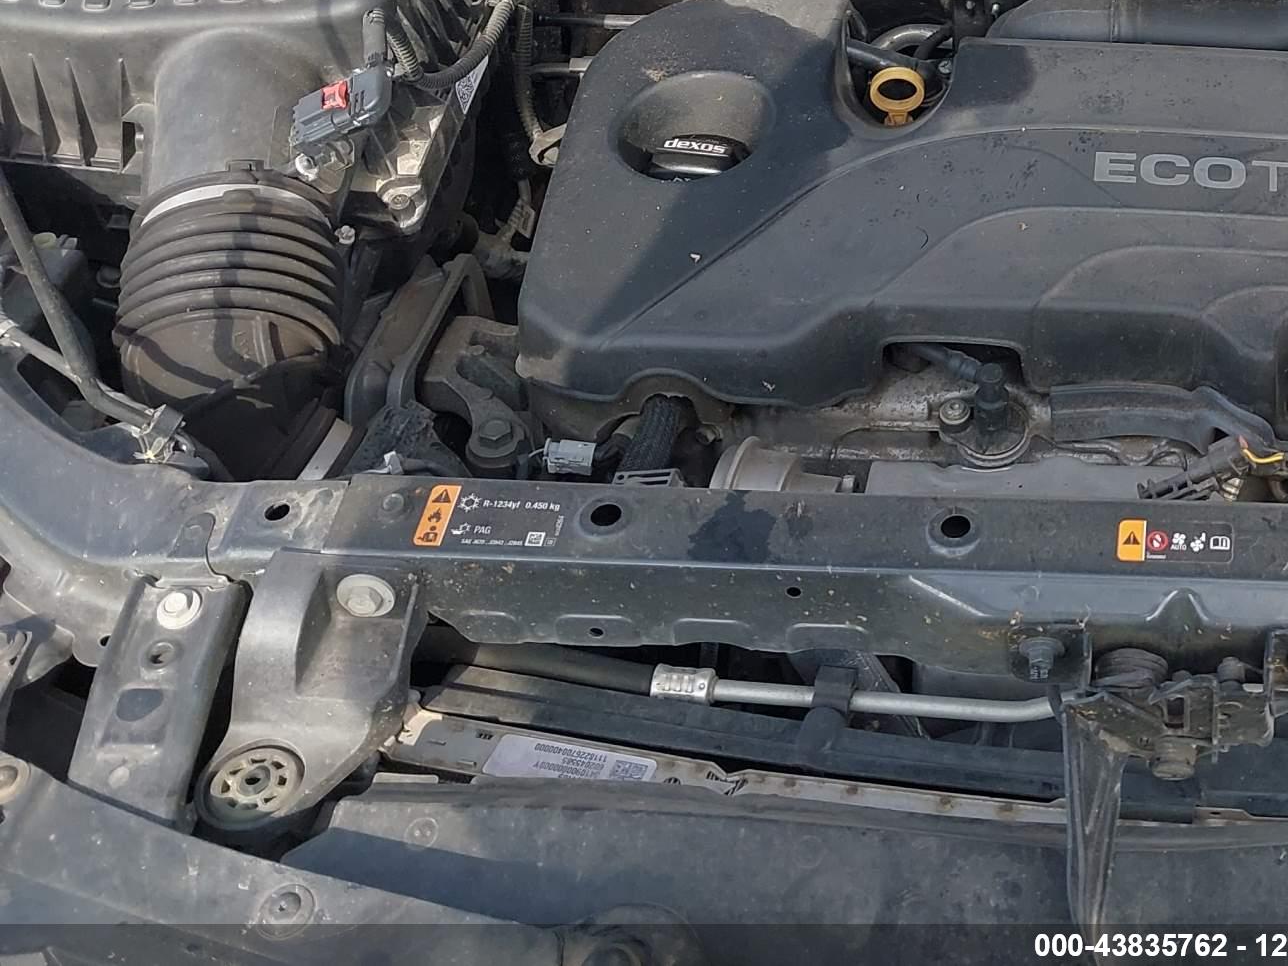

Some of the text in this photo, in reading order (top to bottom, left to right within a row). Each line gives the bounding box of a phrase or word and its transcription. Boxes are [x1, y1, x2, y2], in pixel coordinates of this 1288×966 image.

[664, 138, 728, 153] dexos
[483, 499, 561, 512] R-1234yf 0.450 kg
[474, 525, 492, 534] PAG
